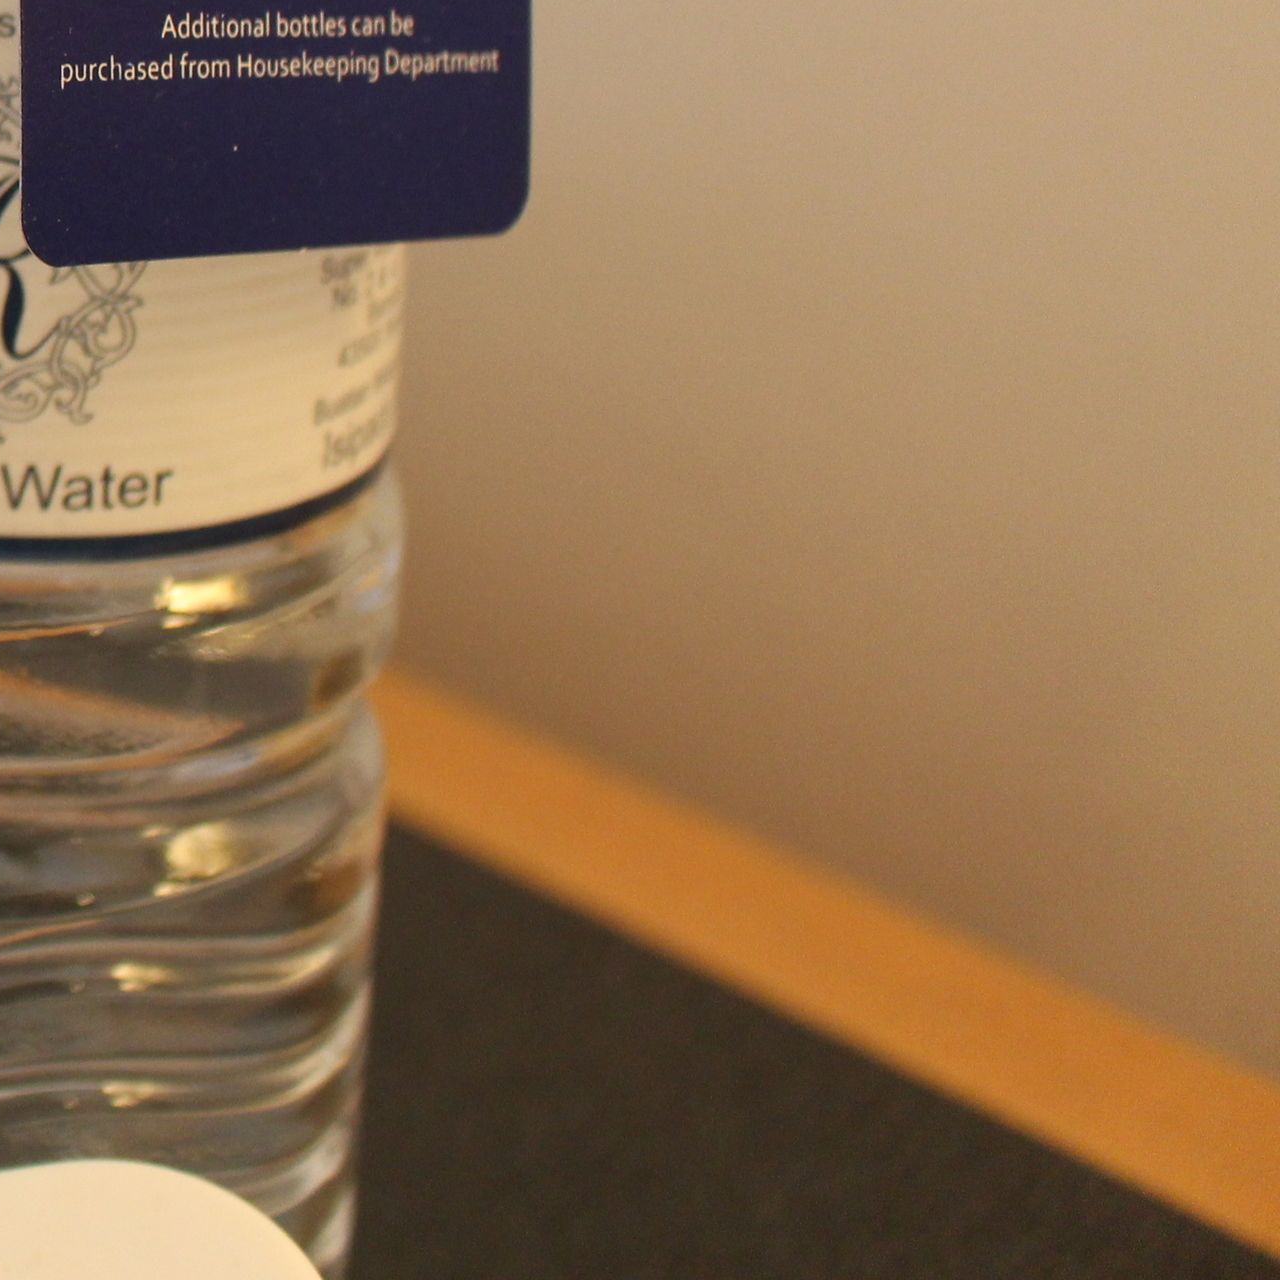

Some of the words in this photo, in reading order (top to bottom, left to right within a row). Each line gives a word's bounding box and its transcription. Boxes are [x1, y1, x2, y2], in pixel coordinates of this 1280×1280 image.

[161, 13, 271, 40] Additional
[276, 10, 347, 38] bottles
[351, 16, 386, 37] can
[390, 9, 416, 37] be
[60, 53, 174, 89] purchased
[179, 52, 232, 79] from
[237, 50, 380, 83] Housekeeping
[384, 48, 501, 82] Department
[1, 463, 174, 512] Water
